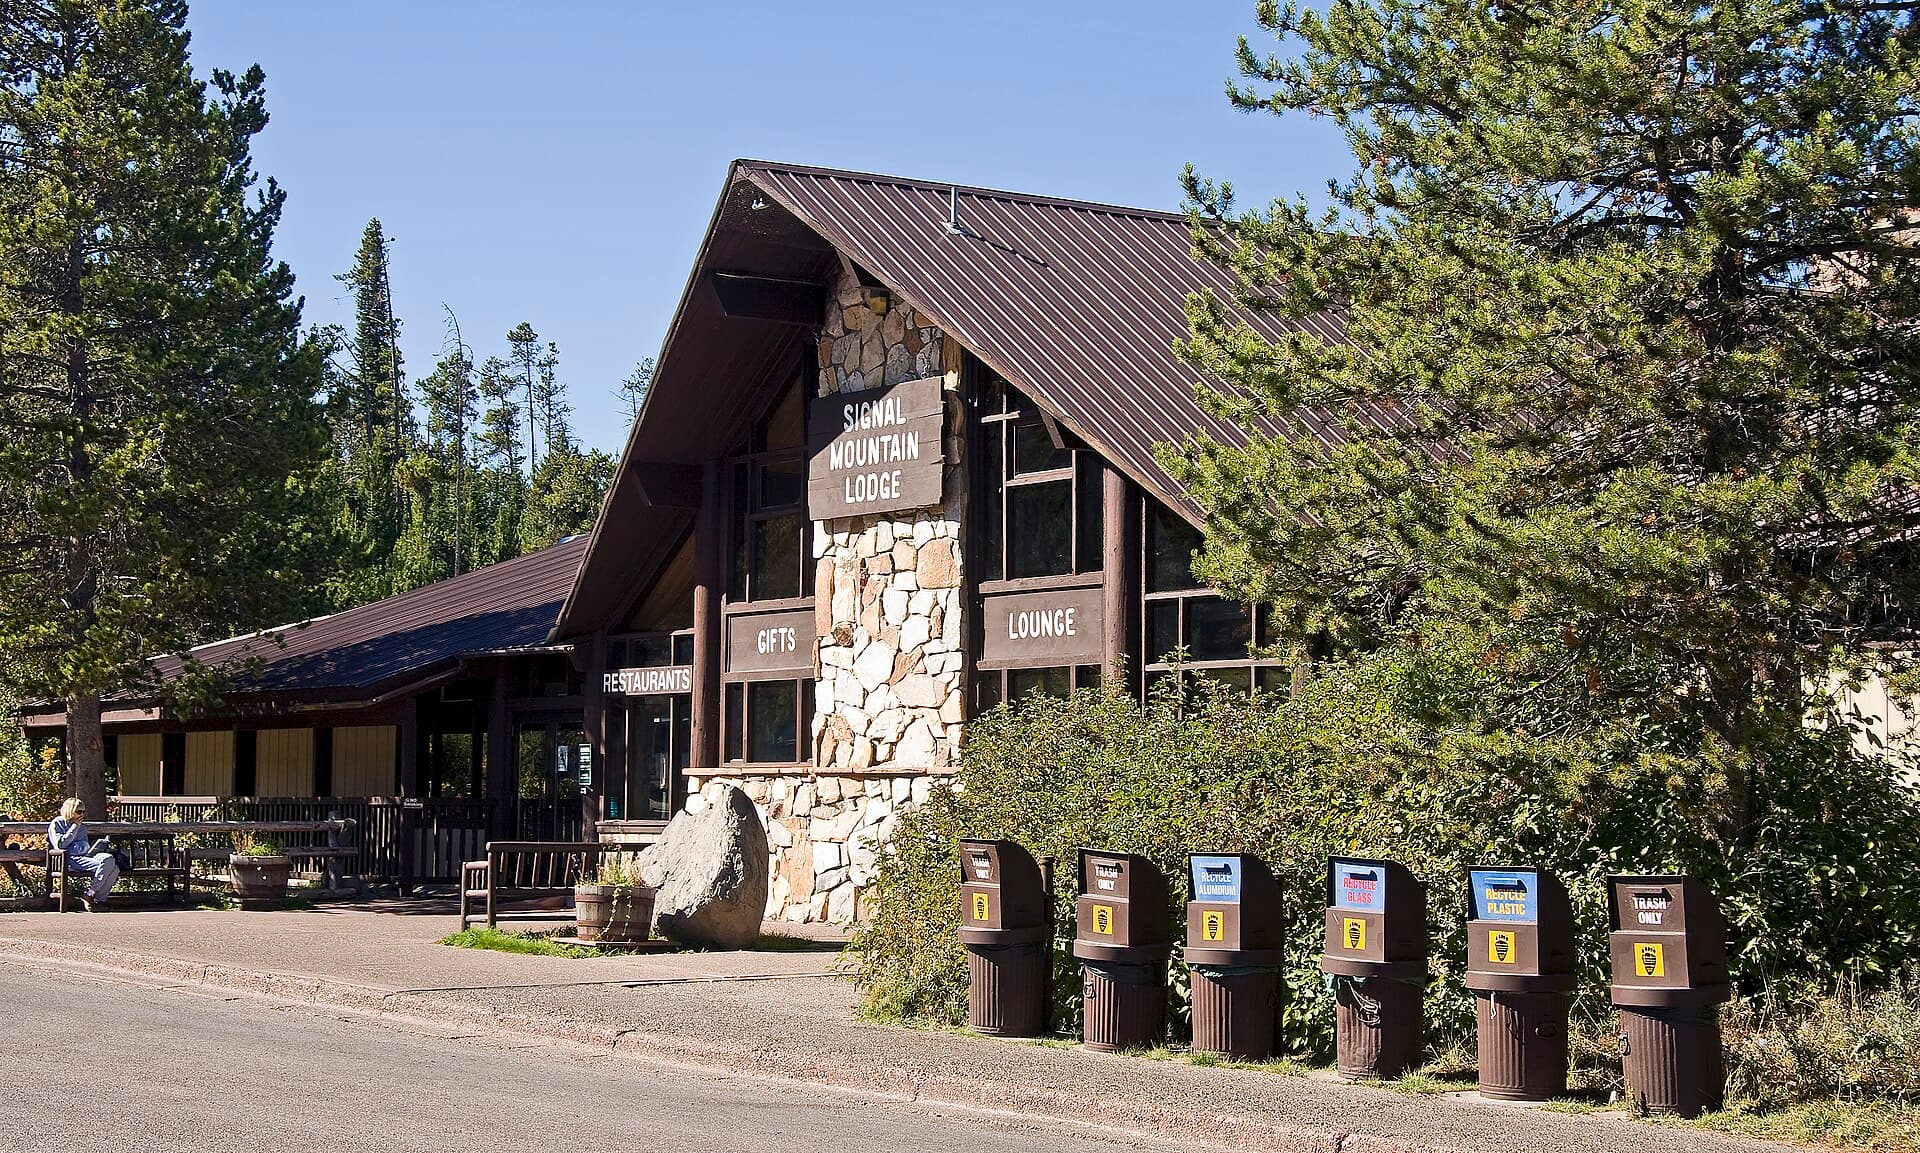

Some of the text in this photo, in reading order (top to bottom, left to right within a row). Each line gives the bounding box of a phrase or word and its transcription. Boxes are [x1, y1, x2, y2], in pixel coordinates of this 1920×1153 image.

[844, 397, 907, 433] SIGNAL
[830, 431, 919, 471] MOUNTAIN
[845, 469, 902, 504] LODGE
[1008, 607, 1077, 640] LOUNGE
[757, 627, 796, 654] GIFTS
[603, 668, 690, 693] RESTAURANTS
[1095, 865, 1118, 879] TRASH
[1201, 871, 1232, 883] RECYCLE
[1098, 878, 1115, 891] ONLY
[1199, 884, 1236, 896] ALUMINUM
[1343, 877, 1377, 891] RECYCLE
[1347, 891, 1373, 904] GLASS
[1485, 887, 1526, 901] RECYCLE
[1487, 902, 1527, 915] PLASTIC
[1632, 896, 1667, 910] TRASH
[1637, 911, 1663, 925] ONLY
